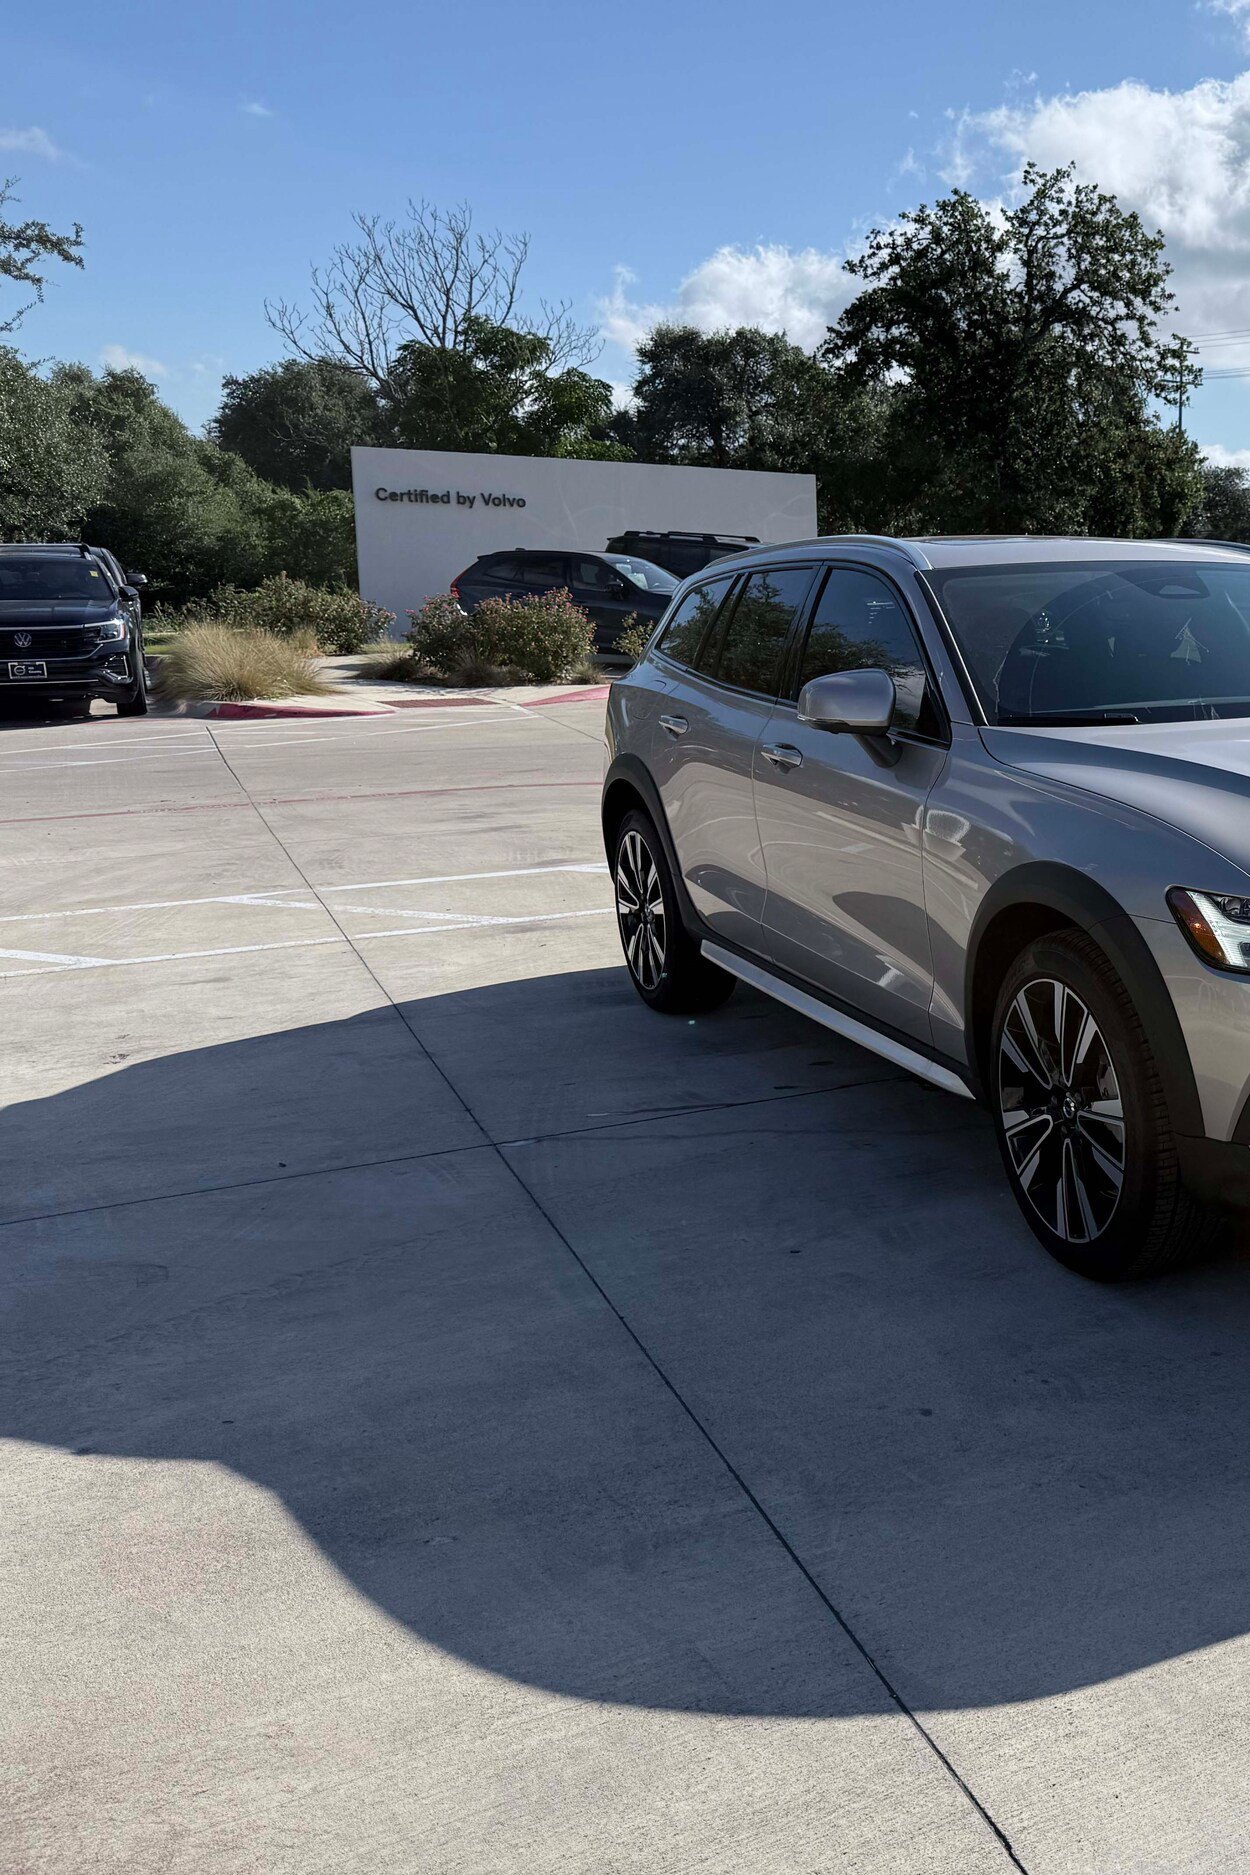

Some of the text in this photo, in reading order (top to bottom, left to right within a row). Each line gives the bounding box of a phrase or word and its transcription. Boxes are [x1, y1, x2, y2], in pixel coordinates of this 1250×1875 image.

[375, 487, 527, 509] Certified by Volvo
